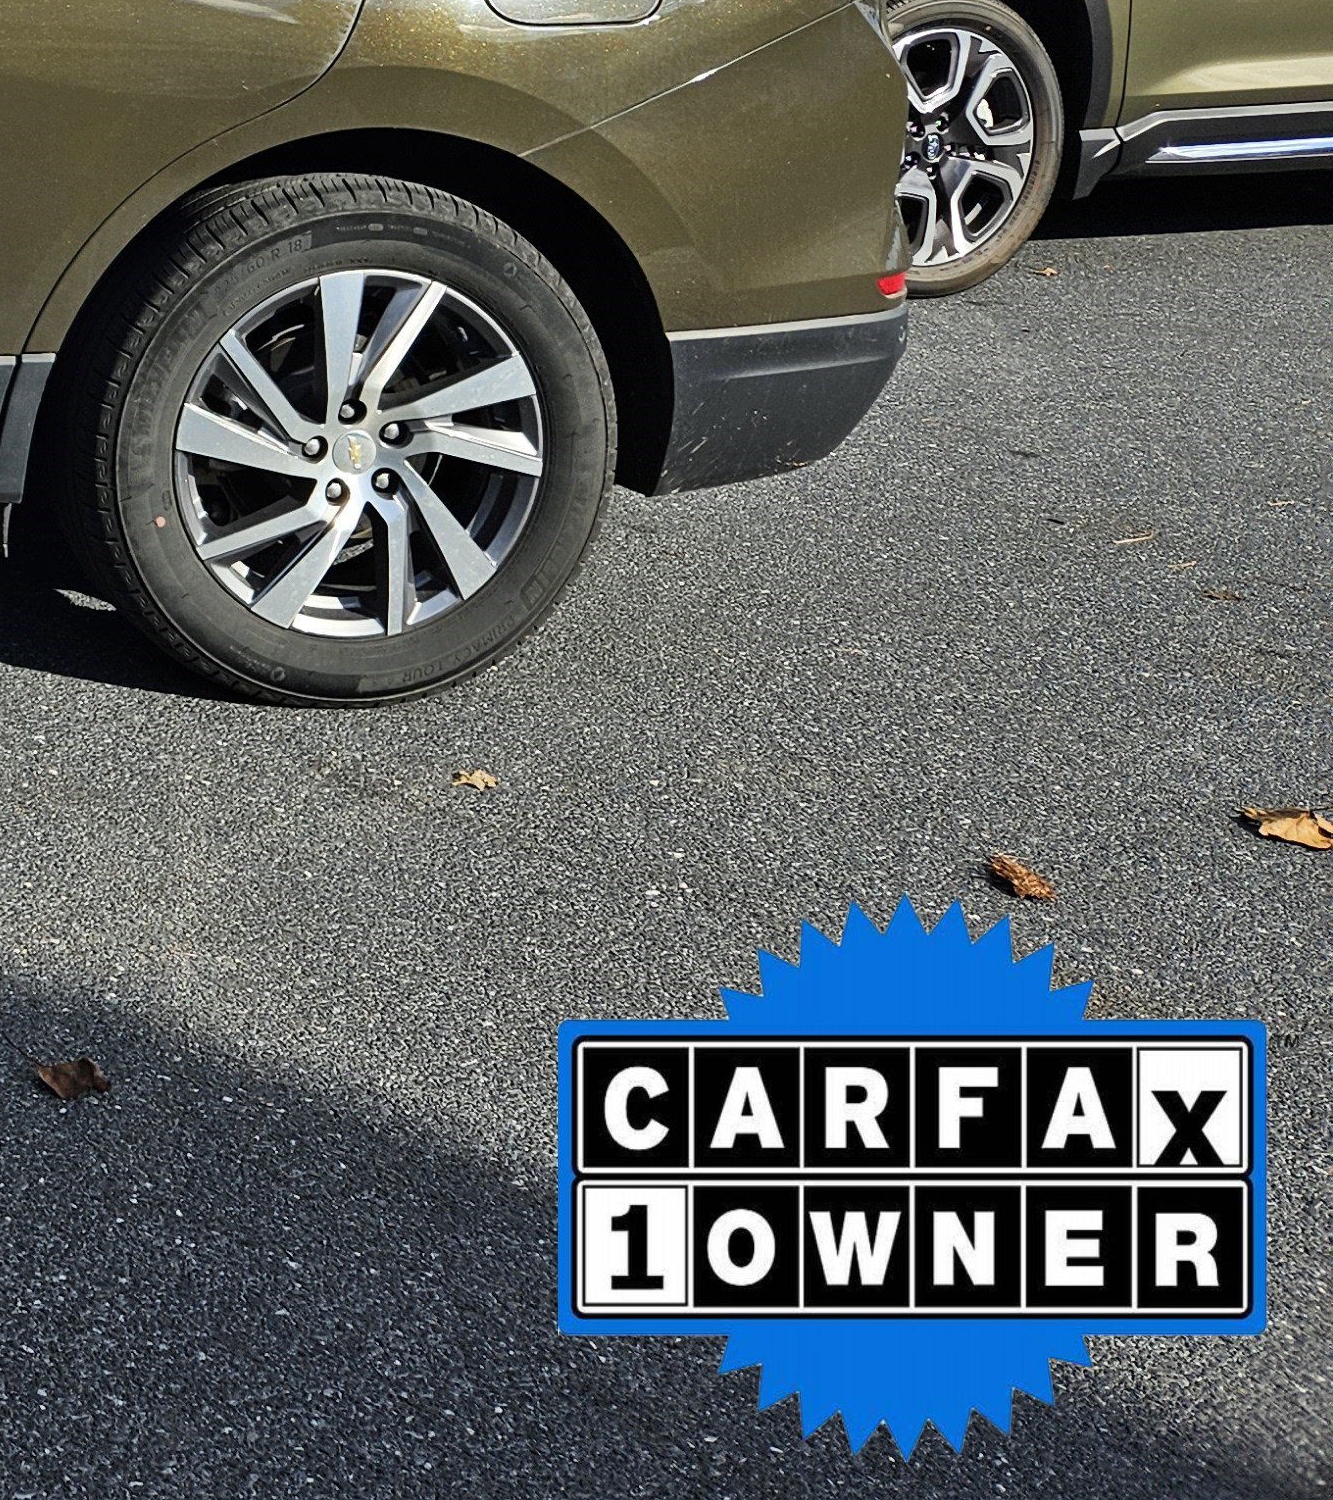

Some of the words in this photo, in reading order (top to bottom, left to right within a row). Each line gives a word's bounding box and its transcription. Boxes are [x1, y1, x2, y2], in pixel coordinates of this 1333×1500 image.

[270, 247, 281, 261] R
[288, 238, 303, 254] 18
[454, 614, 516, 663] PRIMACY
[402, 660, 444, 684] TOUR
